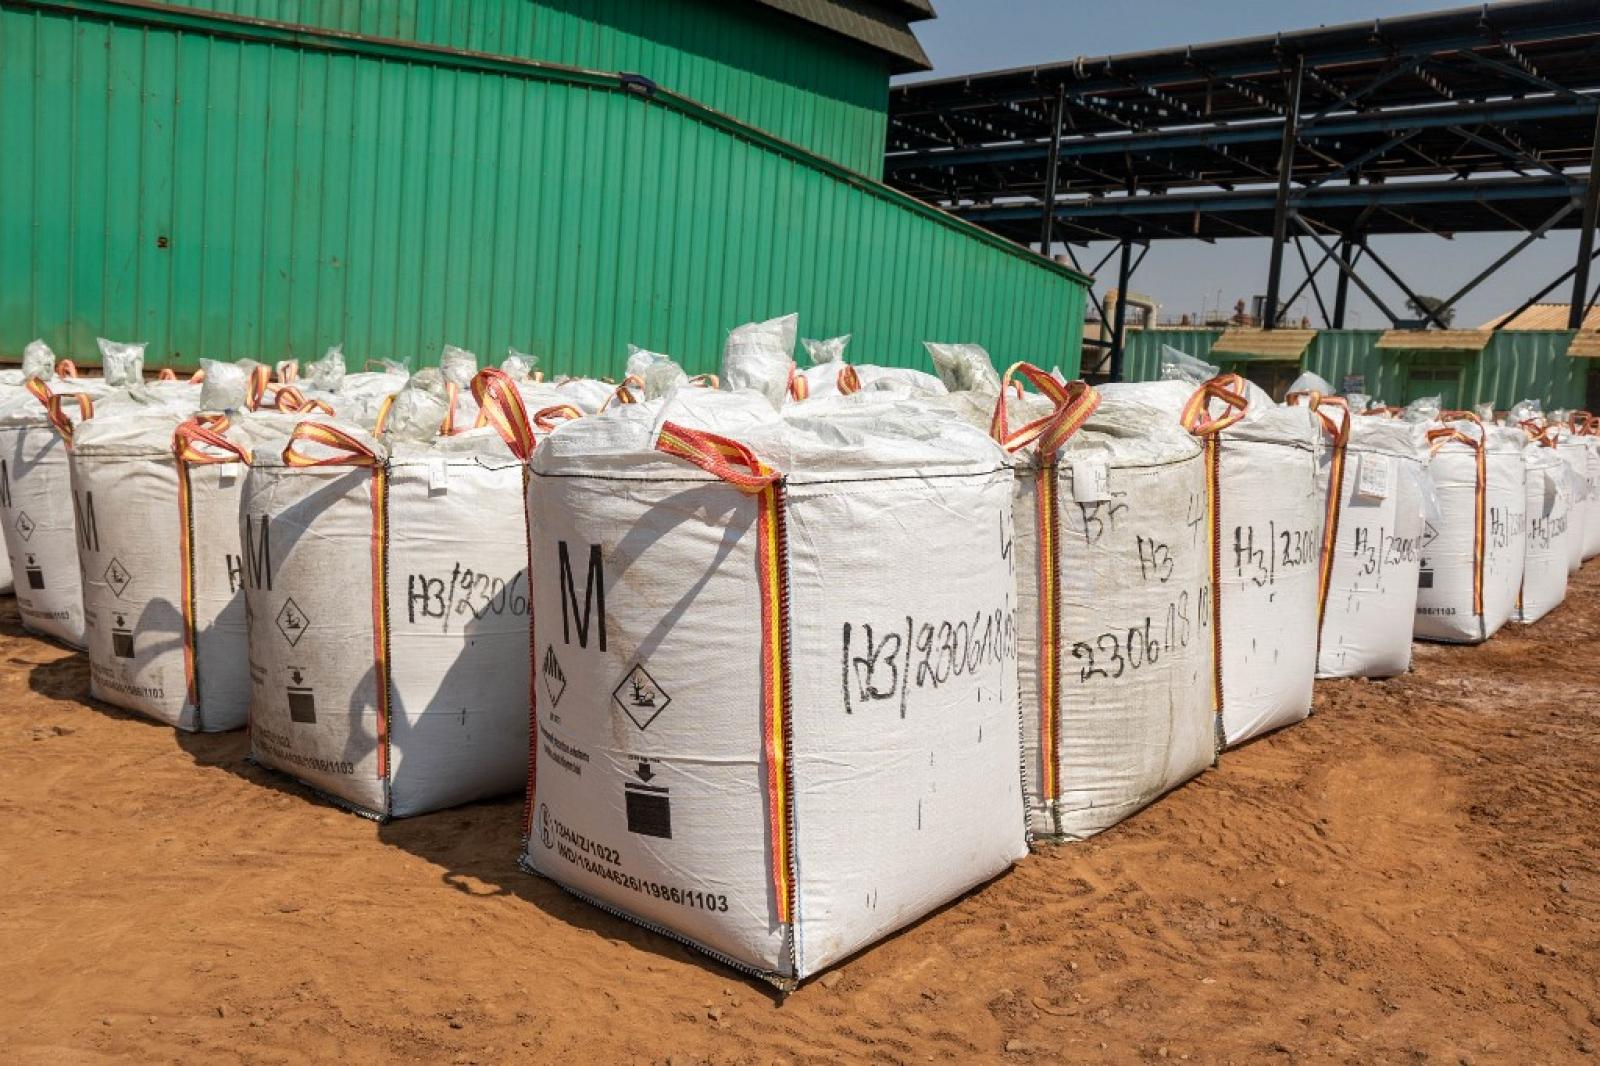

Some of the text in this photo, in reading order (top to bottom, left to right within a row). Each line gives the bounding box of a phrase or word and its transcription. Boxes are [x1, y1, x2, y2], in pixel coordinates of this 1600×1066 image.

[246, 513, 272, 591] M
[1137, 535, 1174, 583] H3
[558, 540, 607, 652] M
